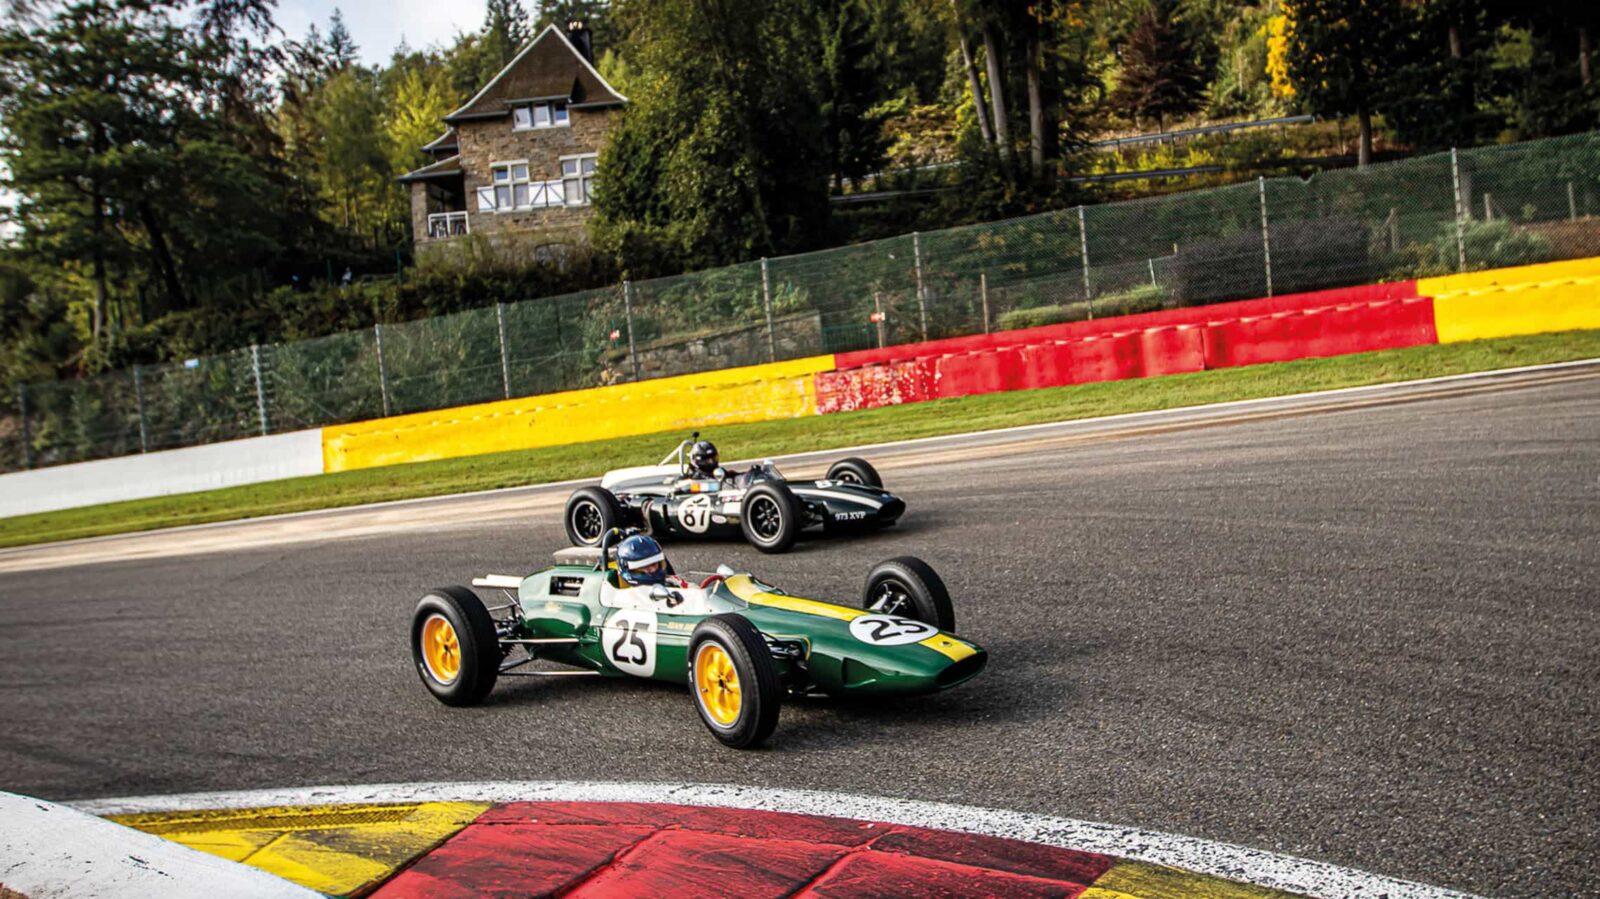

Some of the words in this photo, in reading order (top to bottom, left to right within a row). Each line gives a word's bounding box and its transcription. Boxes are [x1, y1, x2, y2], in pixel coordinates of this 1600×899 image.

[834, 512, 848, 521] 973
[849, 511, 866, 520] XVP
[859, 618, 929, 641] 25
[612, 619, 650, 666] 25
